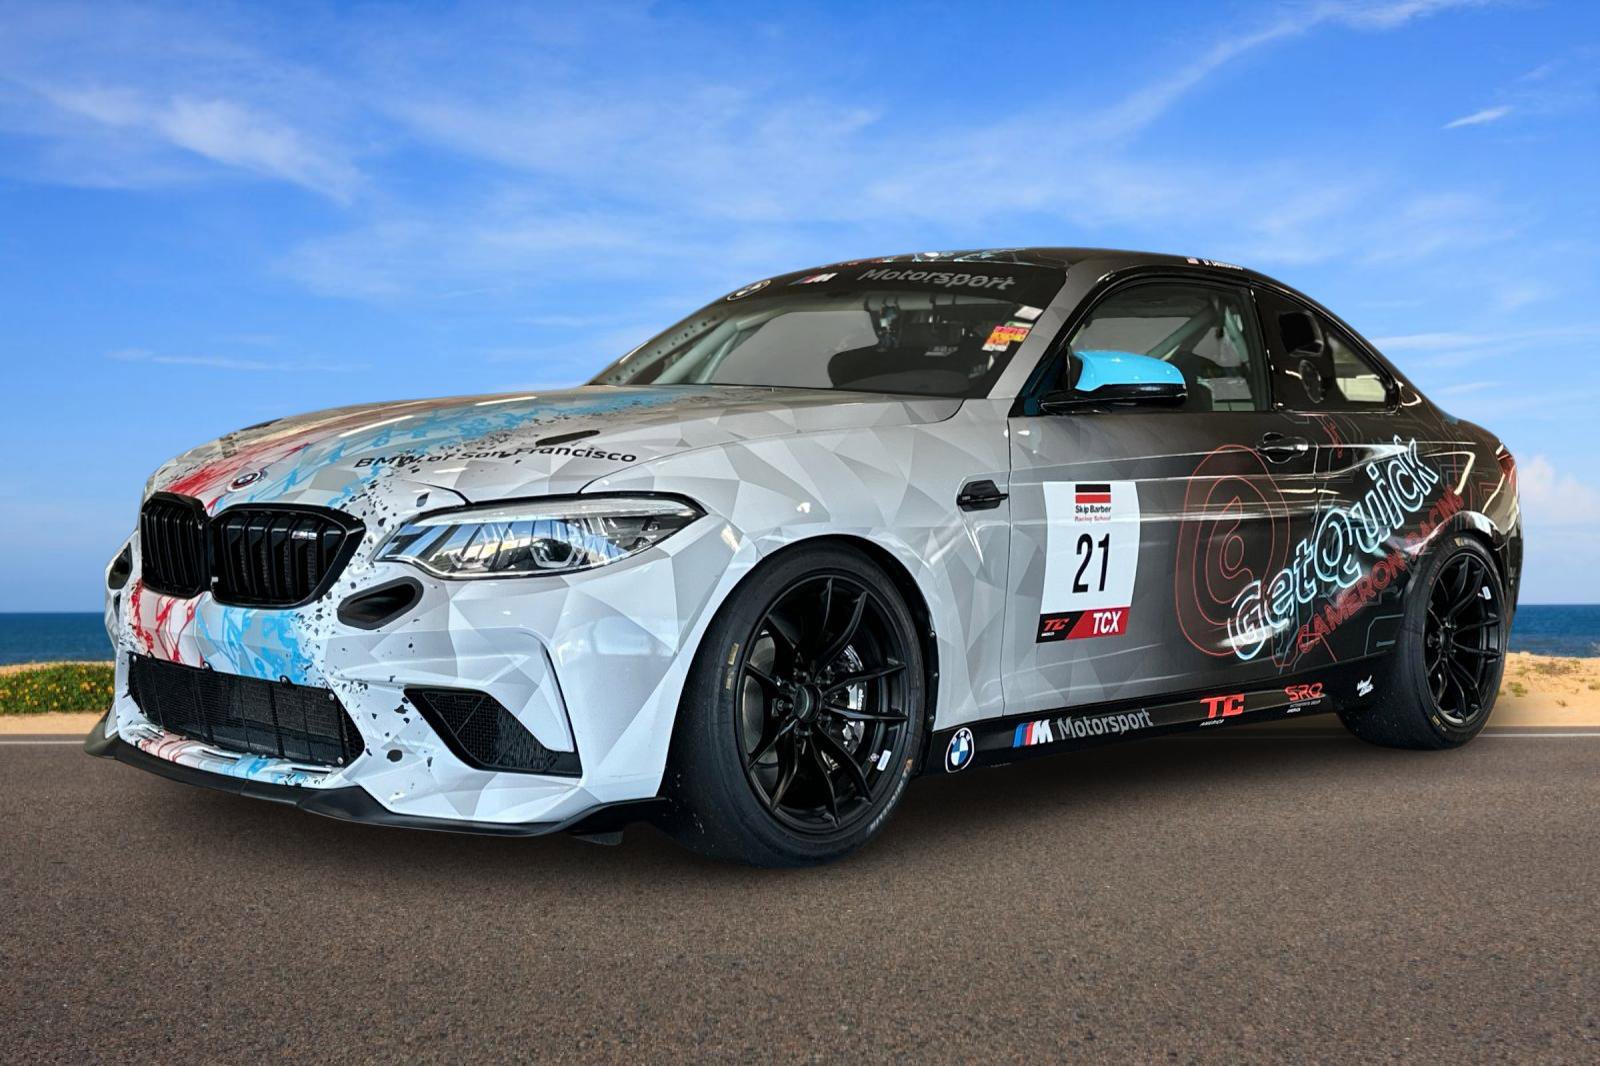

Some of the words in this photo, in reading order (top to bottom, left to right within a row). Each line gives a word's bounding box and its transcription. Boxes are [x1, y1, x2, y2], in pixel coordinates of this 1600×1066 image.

[857, 269, 1015, 290] Motorsport
[354, 454, 424, 468] BMW
[513, 447, 637, 462] Francisco
[1075, 504, 1089, 515] Skip
[1090, 504, 1112, 514] Barber
[1227, 434, 1439, 660] GetQuick
[1072, 533, 1111, 594] 21
[1043, 617, 1070, 632] TC
[1093, 611, 1122, 635] TCX
[1200, 693, 1246, 719] TC
[1057, 708, 1154, 740] Motorsport
